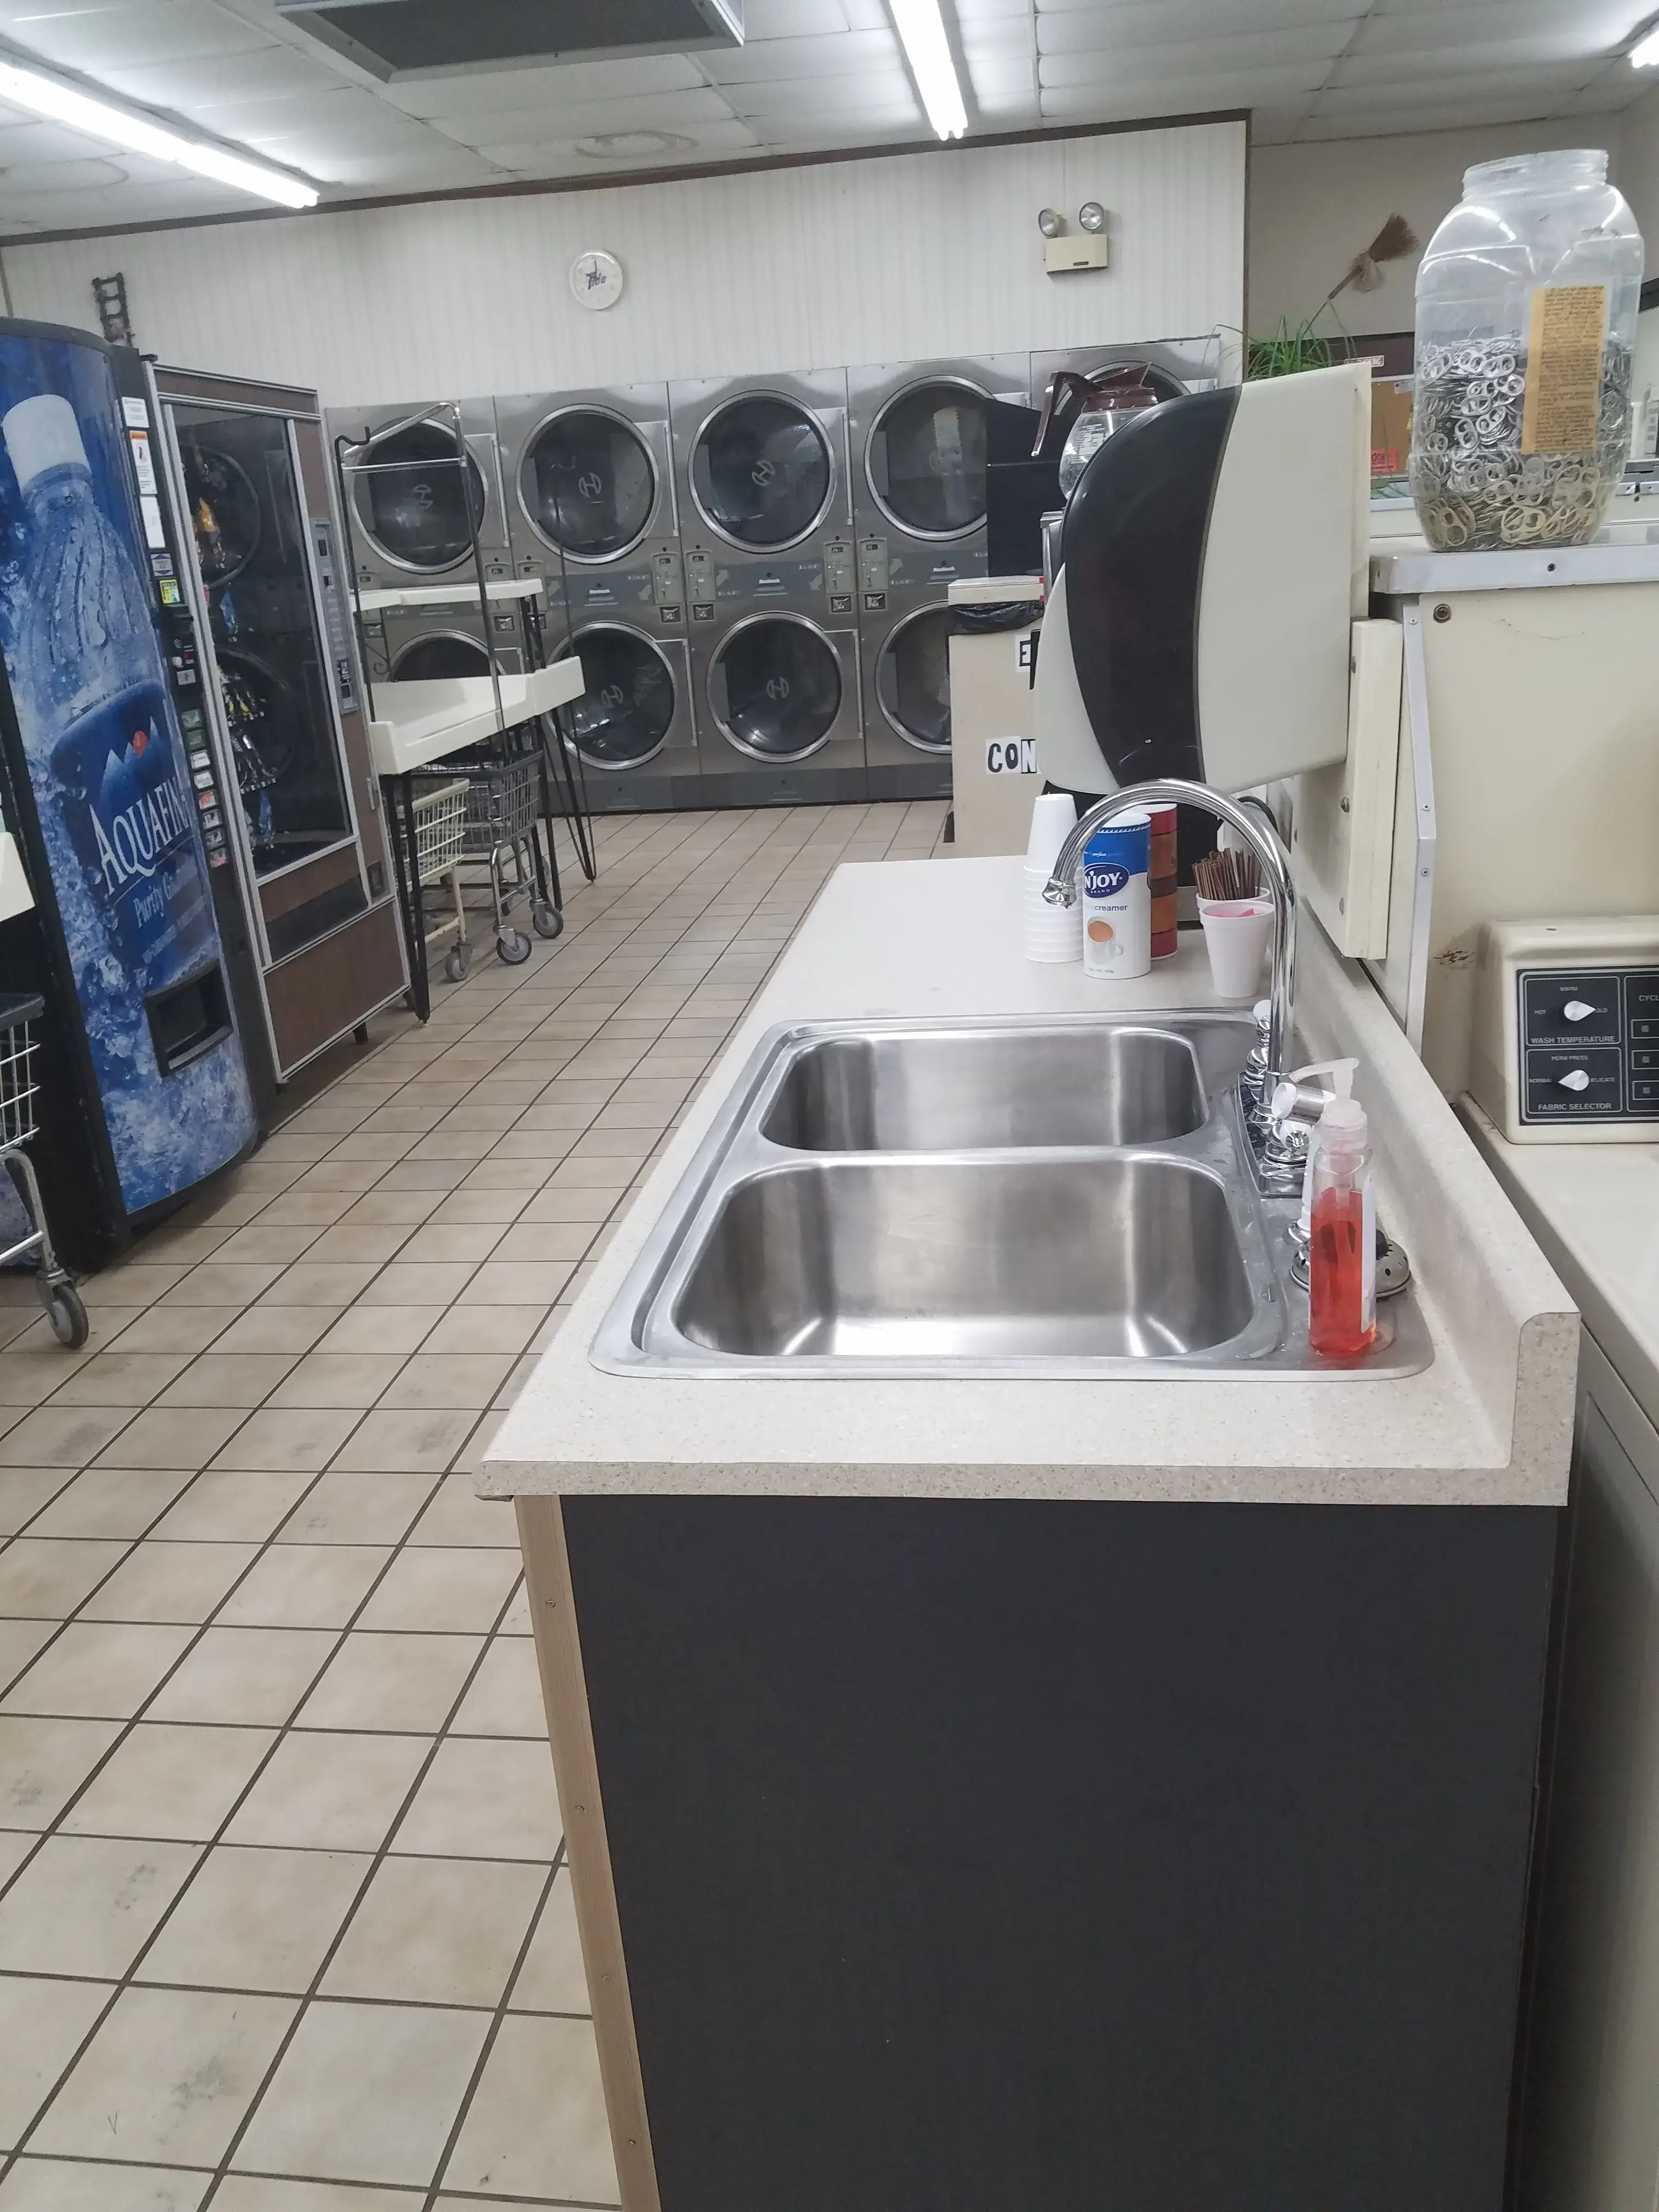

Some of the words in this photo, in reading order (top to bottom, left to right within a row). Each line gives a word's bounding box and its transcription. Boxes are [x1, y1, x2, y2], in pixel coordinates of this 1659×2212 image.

[89, 777, 190, 896] AQUAFIN
[133, 885, 166, 928] Purity
[1094, 904, 1128, 912] creamer
